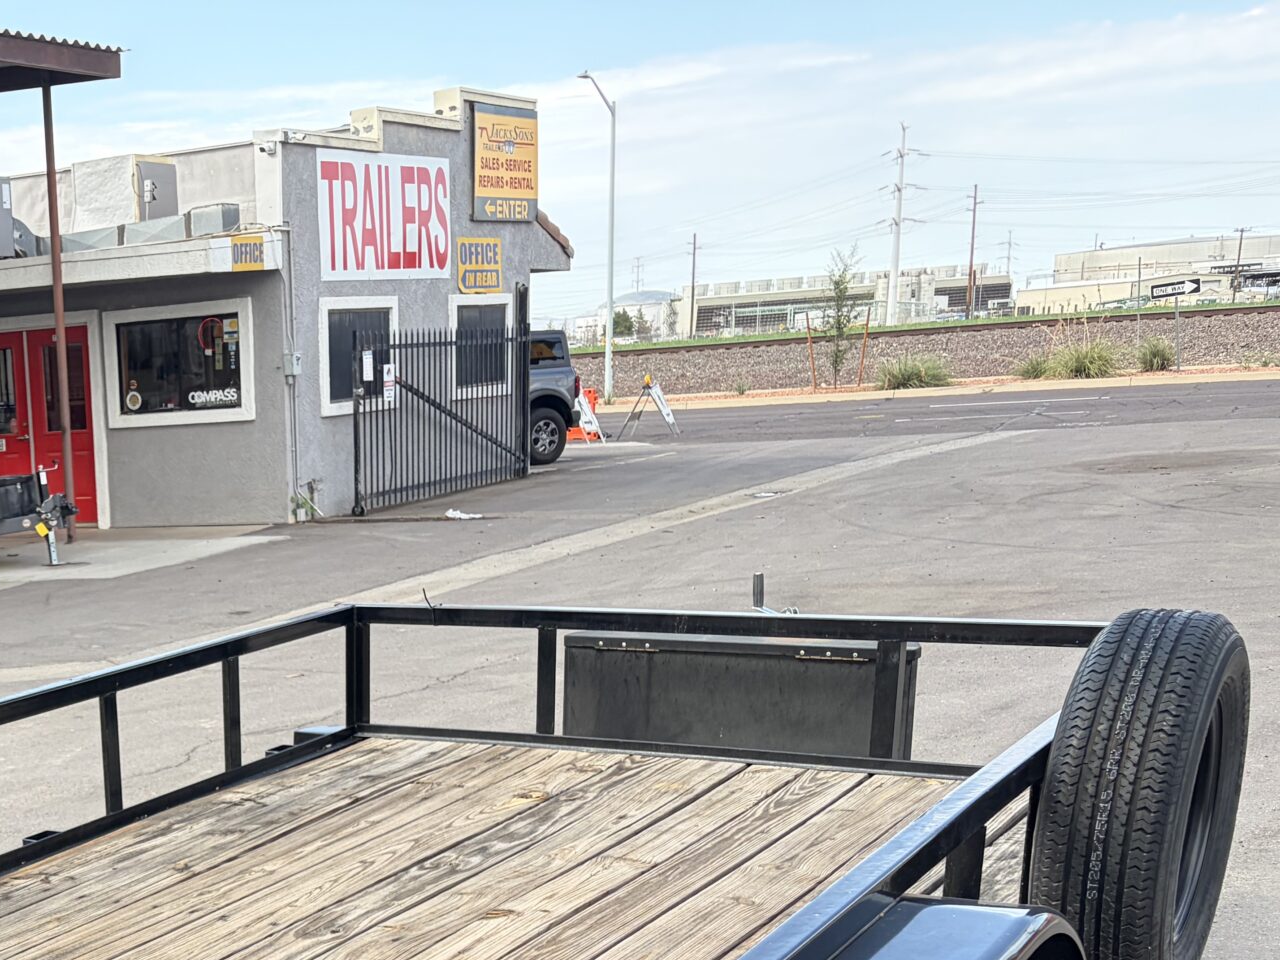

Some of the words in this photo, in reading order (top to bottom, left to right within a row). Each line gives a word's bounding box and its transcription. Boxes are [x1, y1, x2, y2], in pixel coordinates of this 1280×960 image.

[480, 156, 500, 171] SALES
[505, 159, 532, 173] SERVICE
[478, 174, 504, 189] REPAIRS
[509, 177, 534, 191] RENTAL
[320, 161, 449, 271] TRAILERS
[496, 200, 528, 219] ENTER
[233, 243, 263, 264] OFFICE
[460, 242, 499, 265] OFFICE
[466, 272, 475, 286] IN
[477, 272, 497, 286] REAR
[188, 388, 238, 404] COMPASS
[1086, 790, 1113, 900] ST205/75R15
